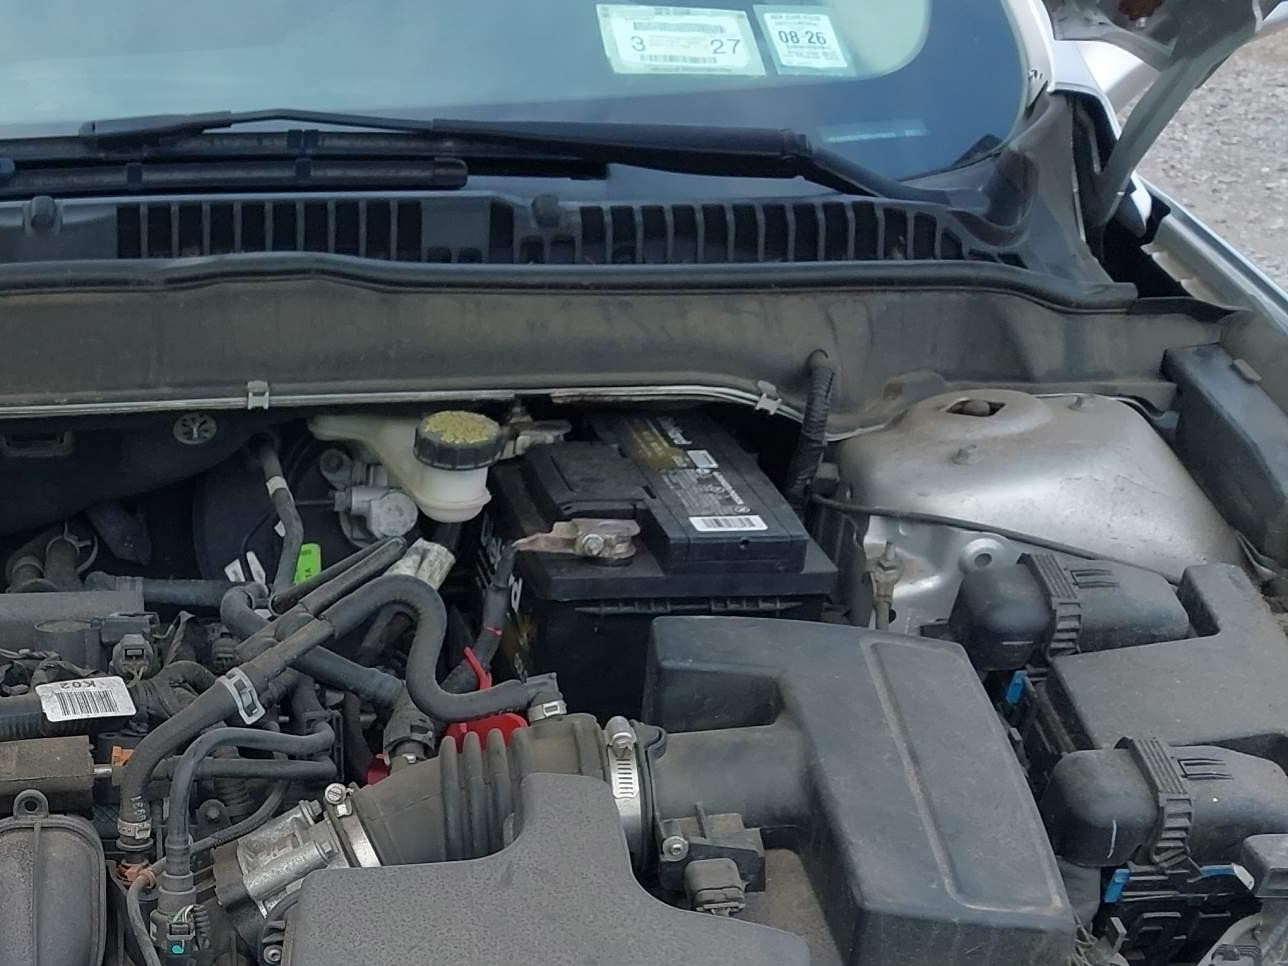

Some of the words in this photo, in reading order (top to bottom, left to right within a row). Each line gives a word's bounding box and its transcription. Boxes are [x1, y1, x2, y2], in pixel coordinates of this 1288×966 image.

[629, 36, 646, 52] 3
[709, 38, 741, 55] 27
[778, 29, 801, 44] 08
[806, 29, 827, 45] 26
